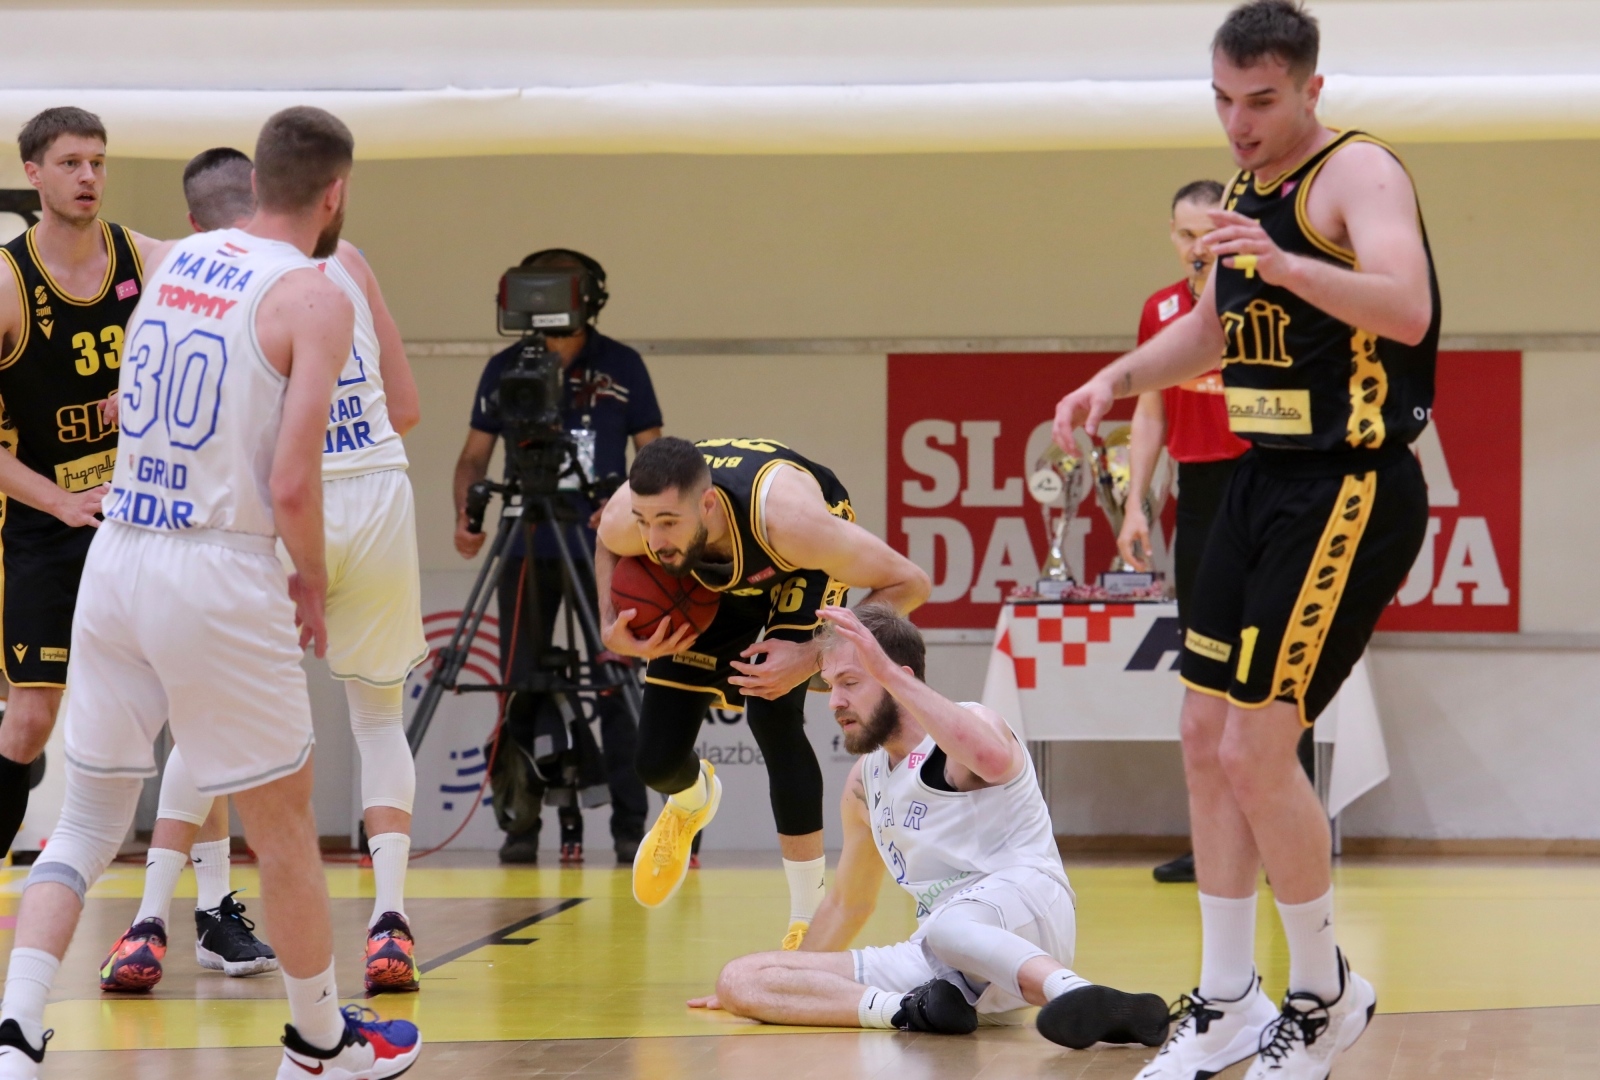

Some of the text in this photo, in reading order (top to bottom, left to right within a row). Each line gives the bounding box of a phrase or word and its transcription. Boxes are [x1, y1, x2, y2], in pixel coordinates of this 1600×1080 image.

[169, 252, 253, 292] MAVRA
[156, 283, 238, 320] TOMMY
[72, 325, 125, 376] 33
[119, 319, 228, 451] 30
[1229, 396, 1302, 420] astika
[106, 487, 194, 530] ZADAR
[1236, 626, 1259, 684] 1
